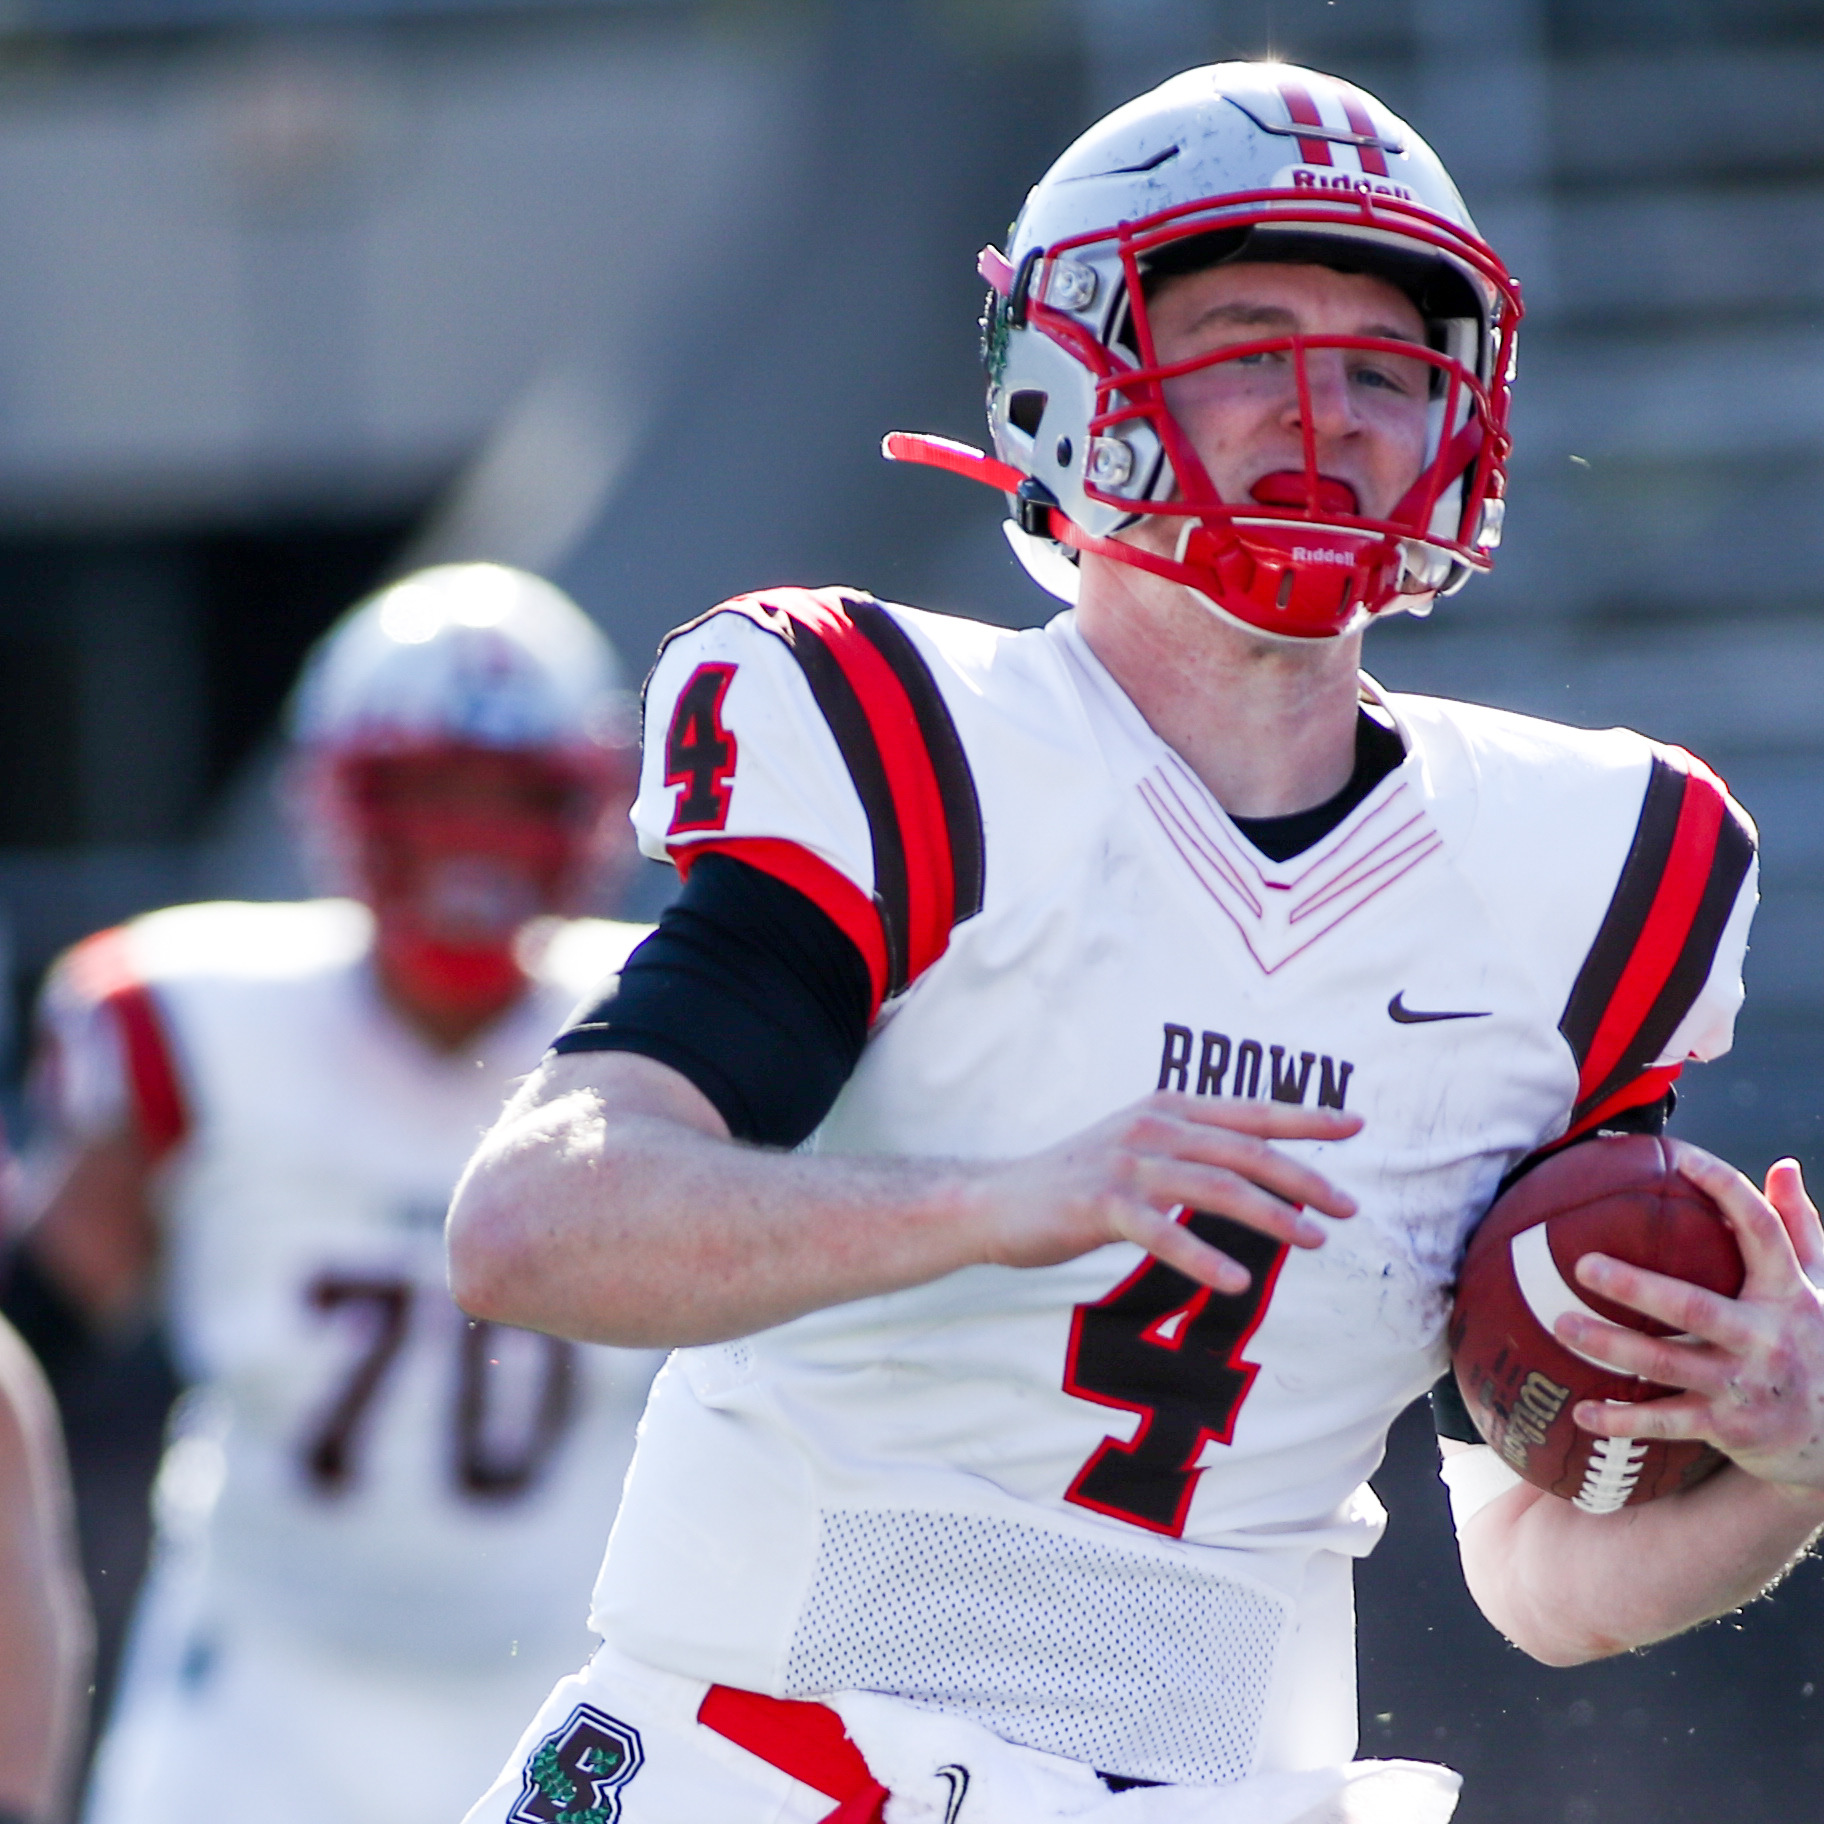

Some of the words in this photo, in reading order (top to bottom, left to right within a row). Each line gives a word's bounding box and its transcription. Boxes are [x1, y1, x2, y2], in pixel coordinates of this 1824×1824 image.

[1291, 545, 1356, 567] Riddell
[664, 660, 738, 834] 4
[1159, 1023, 1354, 1110] BROWN
[306, 1272, 581, 1500] 70
[1062, 1203, 1303, 1540] 4
[1503, 1370, 1572, 1471] Wilson
